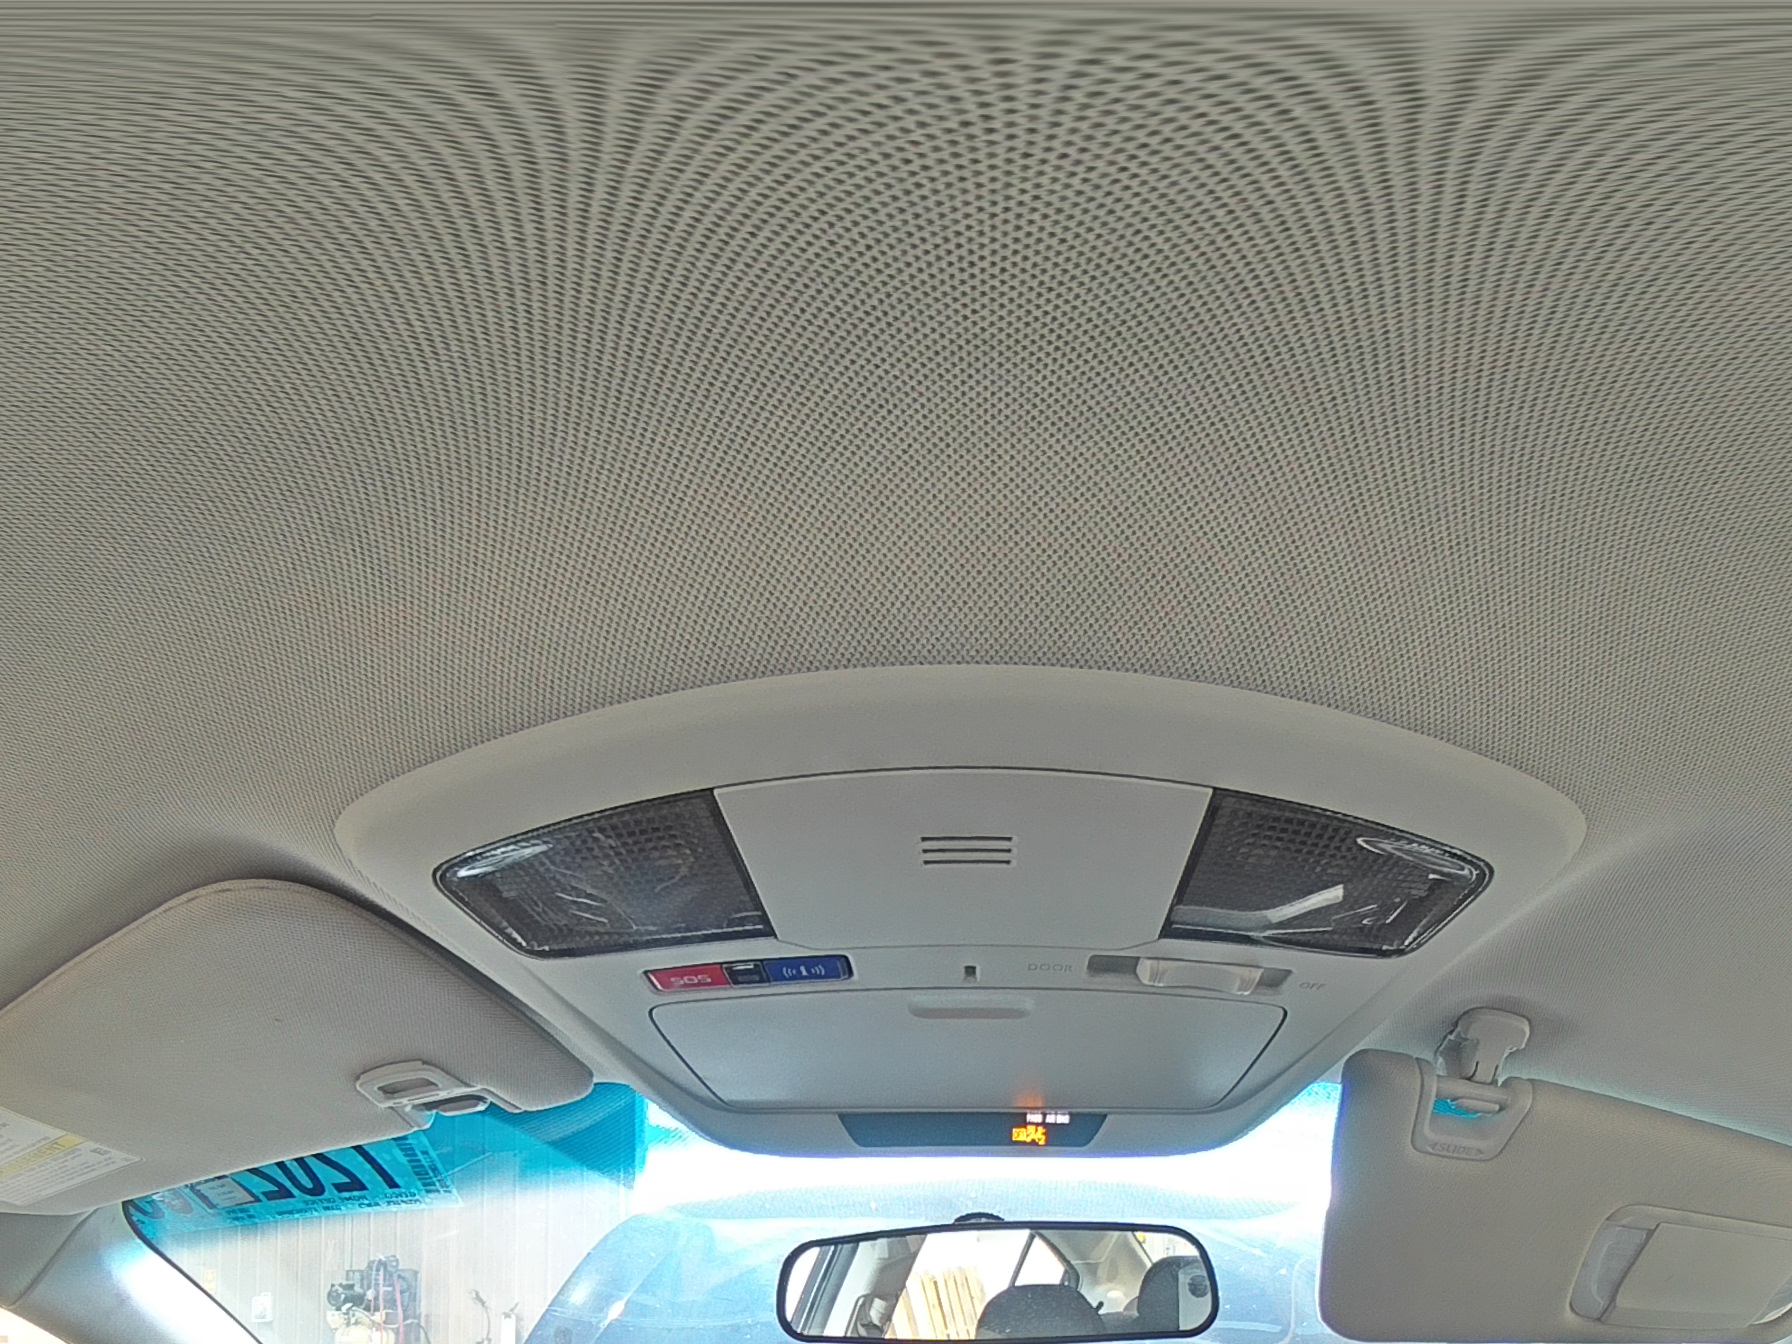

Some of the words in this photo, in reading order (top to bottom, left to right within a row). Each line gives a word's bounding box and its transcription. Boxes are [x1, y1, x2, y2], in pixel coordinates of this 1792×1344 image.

[1028, 962, 1073, 973] DOOR
[670, 975, 712, 985] SOS
[1299, 981, 1326, 990] OFF
[1439, 1143, 1475, 1155] SLIDE
